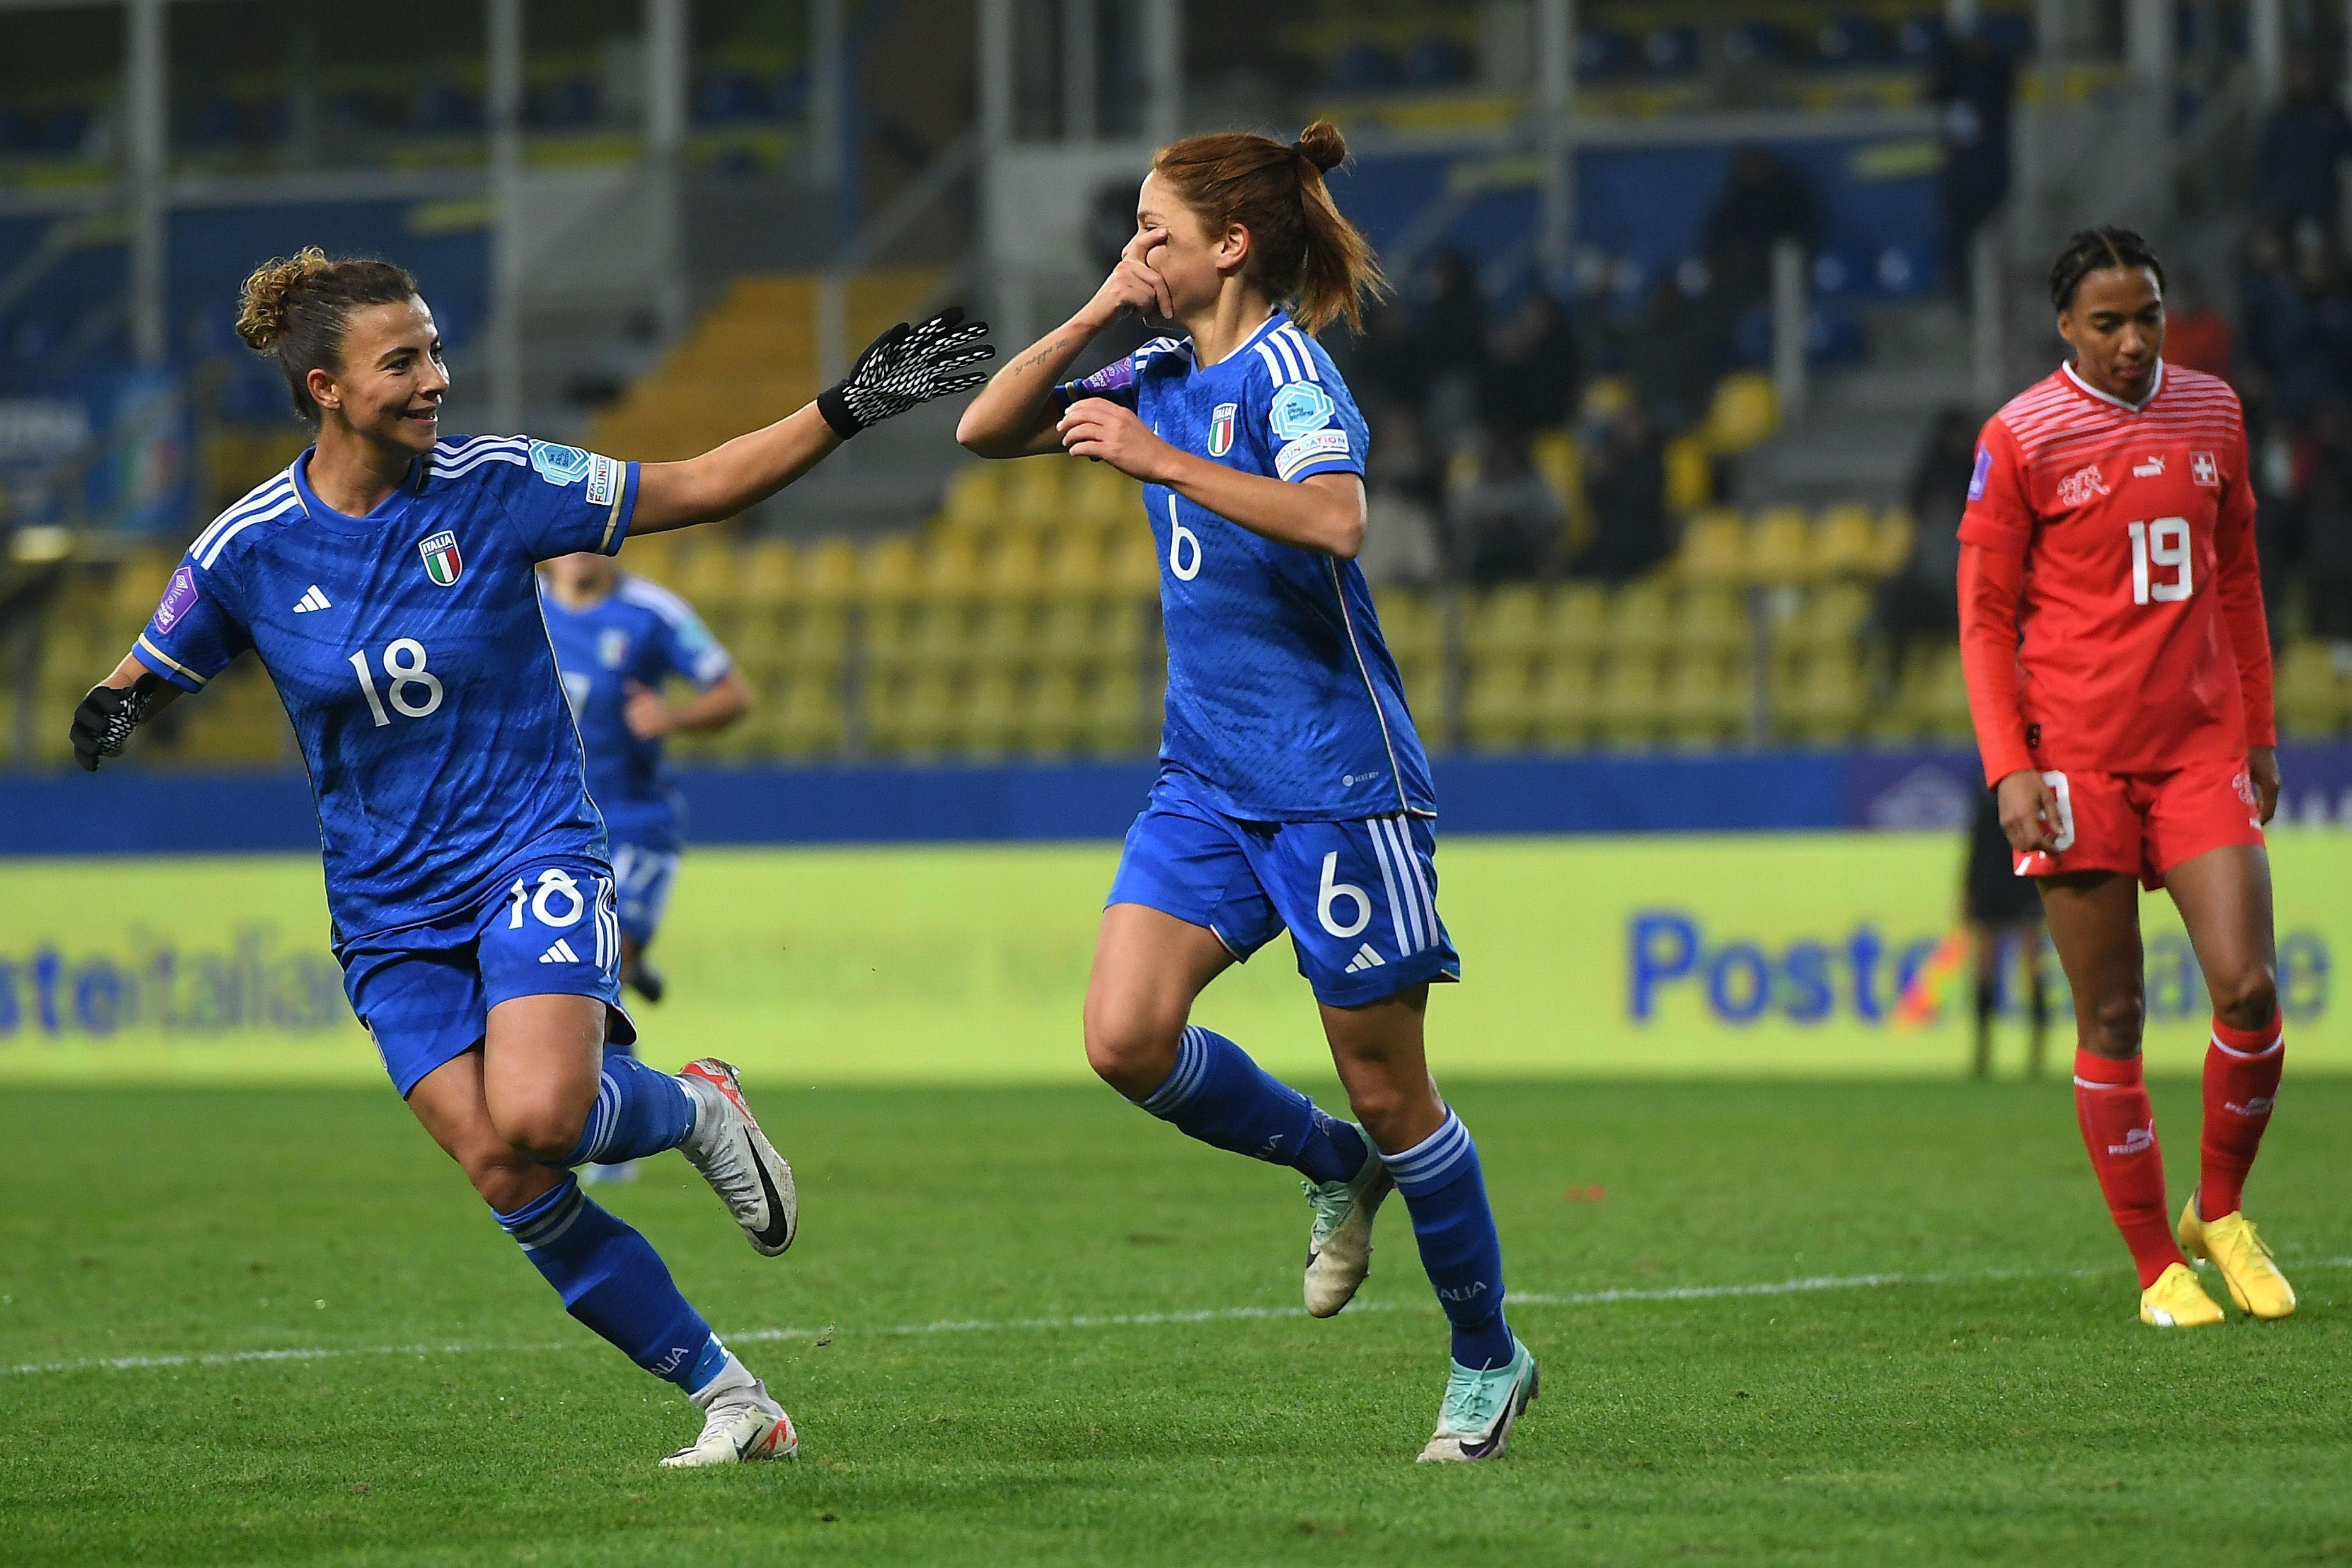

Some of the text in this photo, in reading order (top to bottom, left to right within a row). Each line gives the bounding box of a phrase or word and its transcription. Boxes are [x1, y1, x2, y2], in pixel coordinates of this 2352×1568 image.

[422, 534, 453, 554] ITALIA
[1168, 493, 1202, 581] 6
[2128, 516, 2193, 606] 19
[348, 637, 444, 727] 18
[508, 868, 584, 930] 18
[1317, 850, 1371, 938] 6
